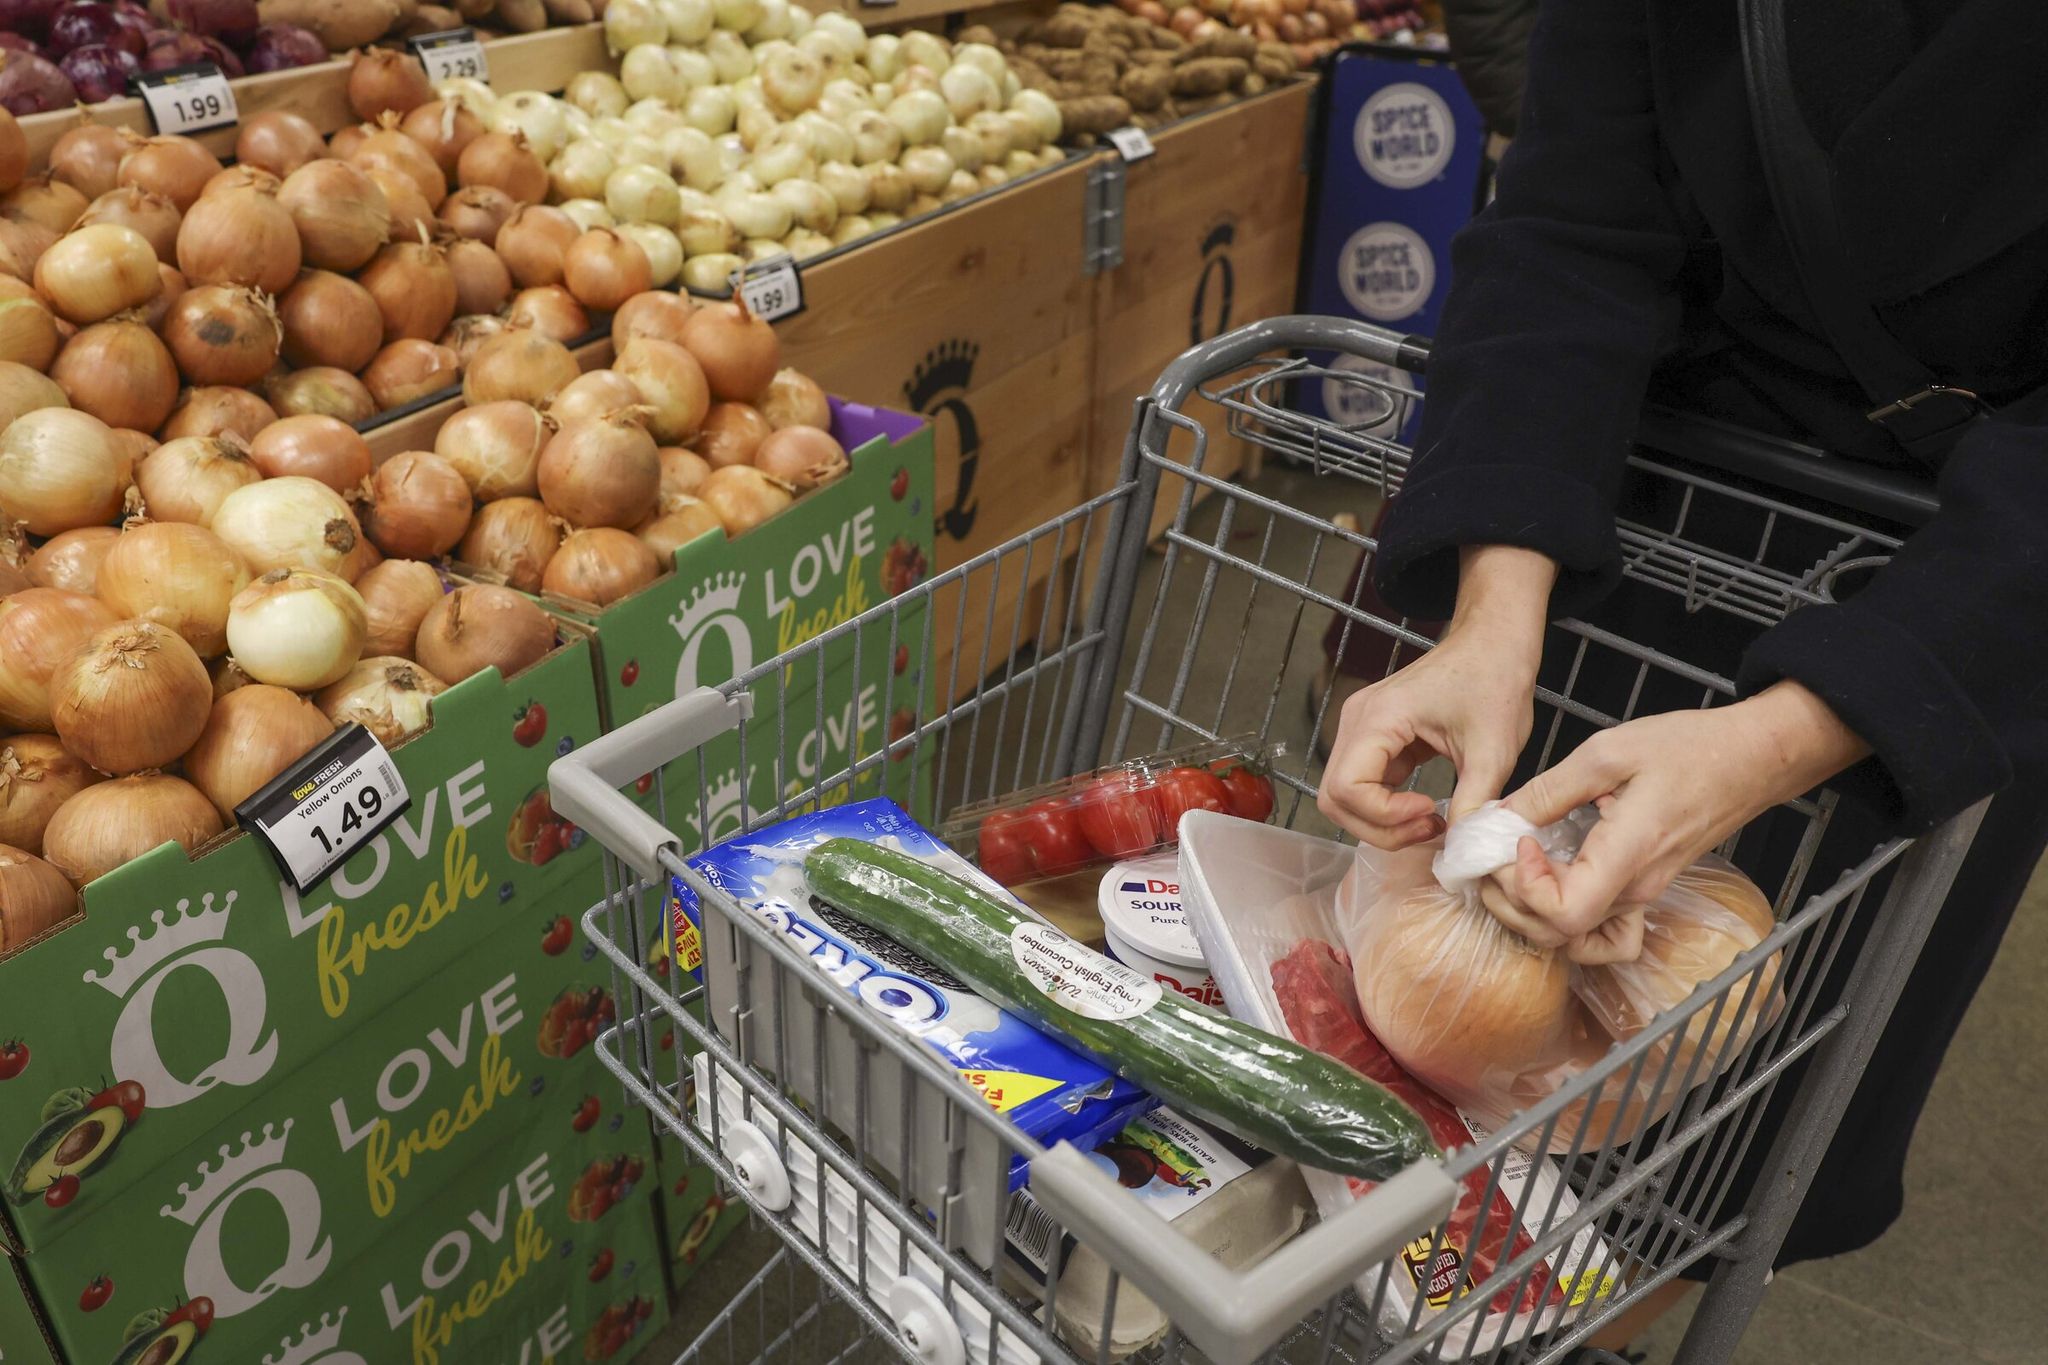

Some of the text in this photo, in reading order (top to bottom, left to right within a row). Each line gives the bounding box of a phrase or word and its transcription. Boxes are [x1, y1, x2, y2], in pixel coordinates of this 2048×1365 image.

[441, 57, 478, 79] 229
[174, 94, 221, 122] 1.99
[752, 288, 783, 314] 1.99
[764, 505, 875, 619] LOVE
[777, 553, 870, 688] fresh
[297, 767, 363, 820] Yellow Onions
[314, 760, 344, 786] FRESH
[310, 785, 382, 854] 1.49
[278, 759, 493, 940] LOVE
[1131, 900, 1183, 911] SOUR
[1146, 879, 1180, 895] Da
[1150, 916, 1179, 924] Pure
[316, 905, 490, 1019] fresh
[1019, 933, 1074, 970] Cucumber
[1074, 965, 1114, 993] English
[1086, 985, 1125, 1014] Organic
[110, 946, 279, 1109] Q
[330, 972, 524, 1153] LOVE
[366, 1032, 522, 1218] fresh
[1186, 1138, 1218, 1164] HEALTHY
[183, 1168, 333, 1319] Q
[380, 1152, 555, 1331] LOVE
[412, 1207, 552, 1365] fresh
